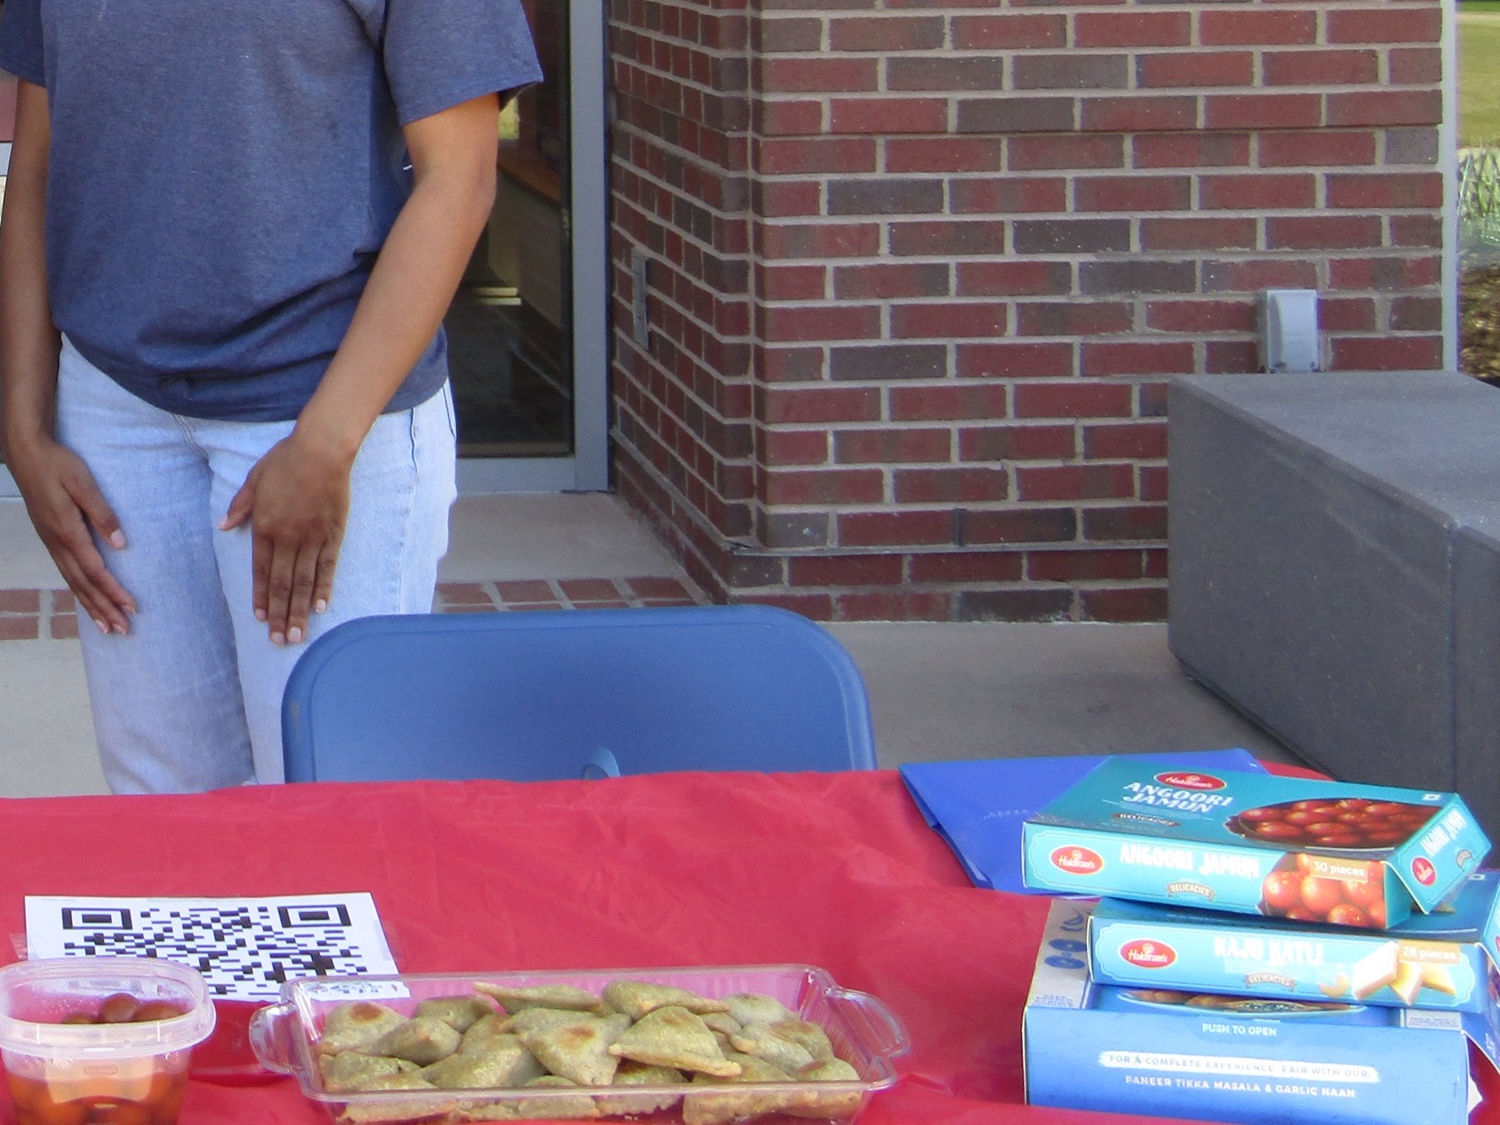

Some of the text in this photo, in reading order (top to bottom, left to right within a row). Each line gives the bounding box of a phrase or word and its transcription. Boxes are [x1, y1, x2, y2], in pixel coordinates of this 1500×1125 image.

[1122, 793, 1214, 813] JAMUN
[1123, 782, 1233, 807] ANGOORI
[1119, 844, 1260, 879] ANGOORI JAMUN
[1313, 861, 1365, 876] 30 pieces
[1170, 882, 1211, 897] DELICACIES
[1213, 936, 1325, 967] KAJU KATLI
[1402, 946, 1456, 961] 28 pieces
[1248, 973, 1292, 987] DELICACIES
[1202, 1023, 1277, 1037] PUSH TO OPEN
[1109, 1054, 1131, 1064] FOR
[1145, 1056, 1202, 1068] COMPLETE
[1281, 1064, 1307, 1074] PAIR
[1311, 1066, 1340, 1077] WITH
[1125, 1075, 1356, 1098] PANEER TIKKA MASALA & GARLIC NAAN
